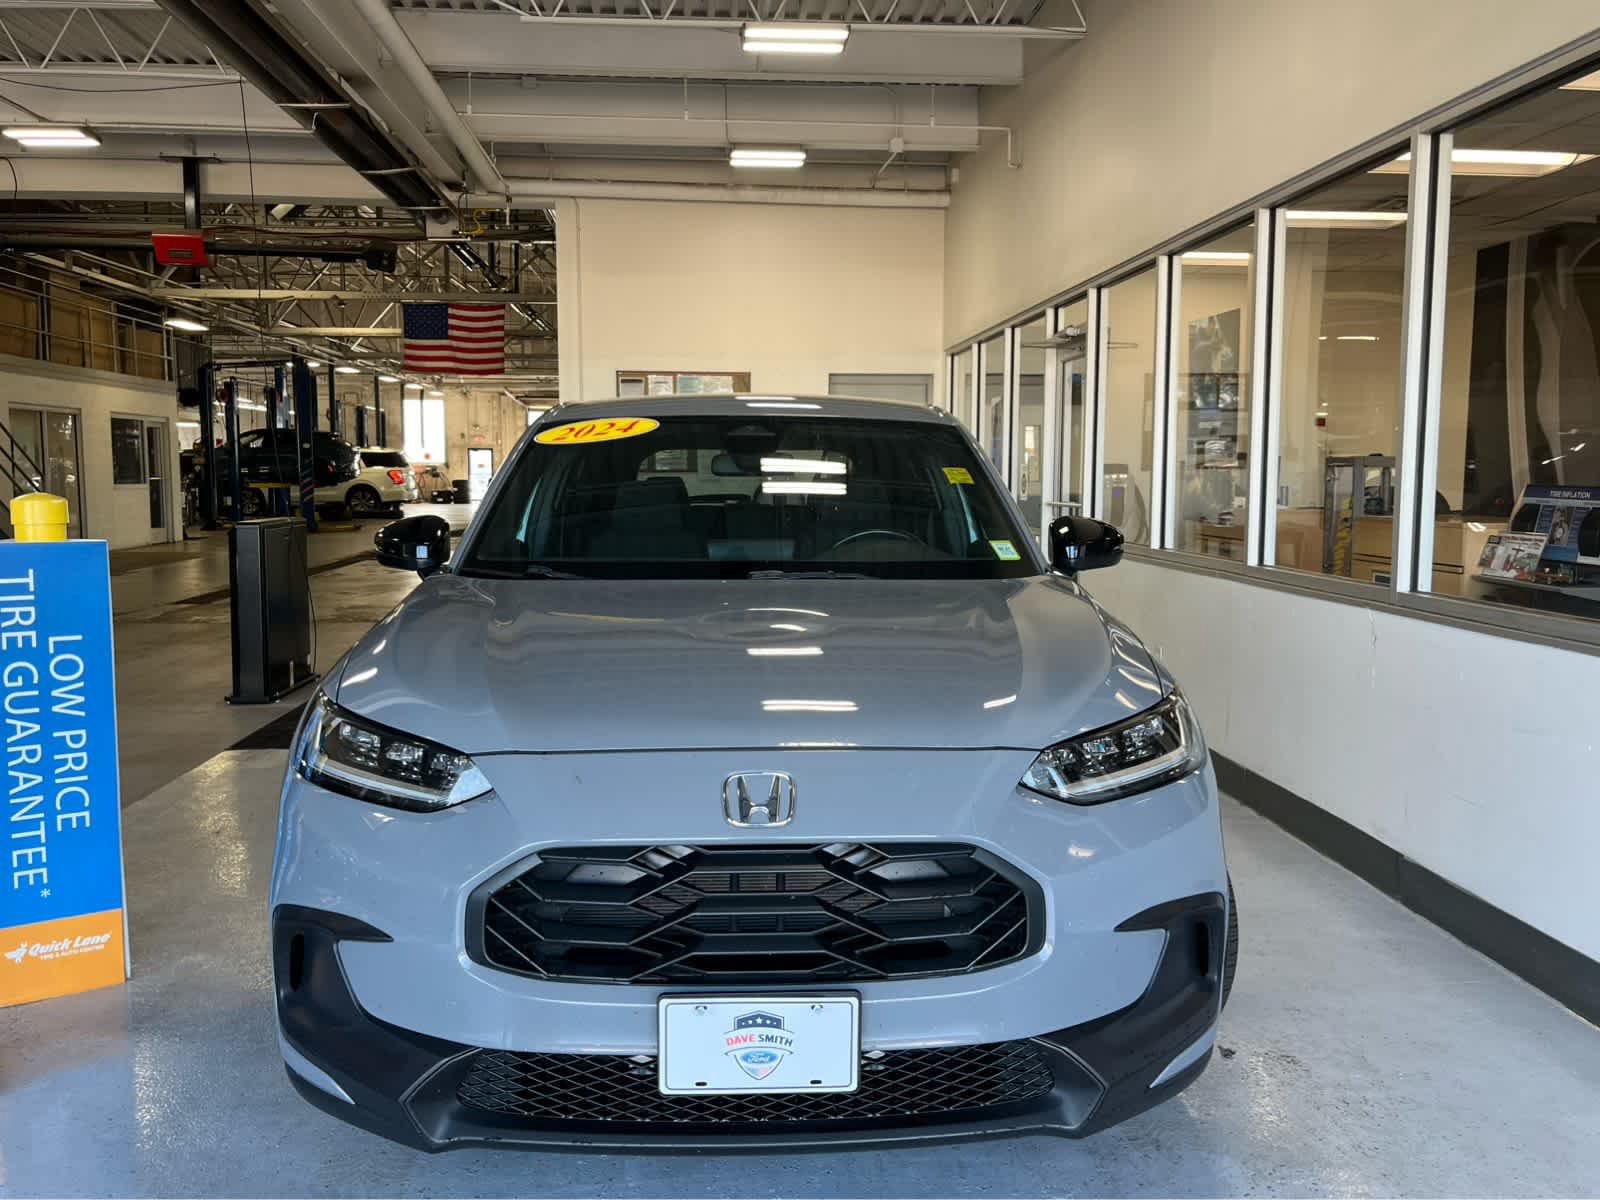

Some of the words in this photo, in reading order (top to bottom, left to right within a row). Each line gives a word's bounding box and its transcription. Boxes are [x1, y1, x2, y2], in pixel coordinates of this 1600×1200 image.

[552, 420, 640, 440] 2024
[0, 568, 37, 650] TIRE
[48, 634, 86, 717] LOW
[52, 729, 91, 832] PRICE
[28, 938, 71, 956] Quick
[73, 933, 111, 948] Lane
[726, 1033, 756, 1046] DAVE
[758, 1033, 793, 1047] SMITH
